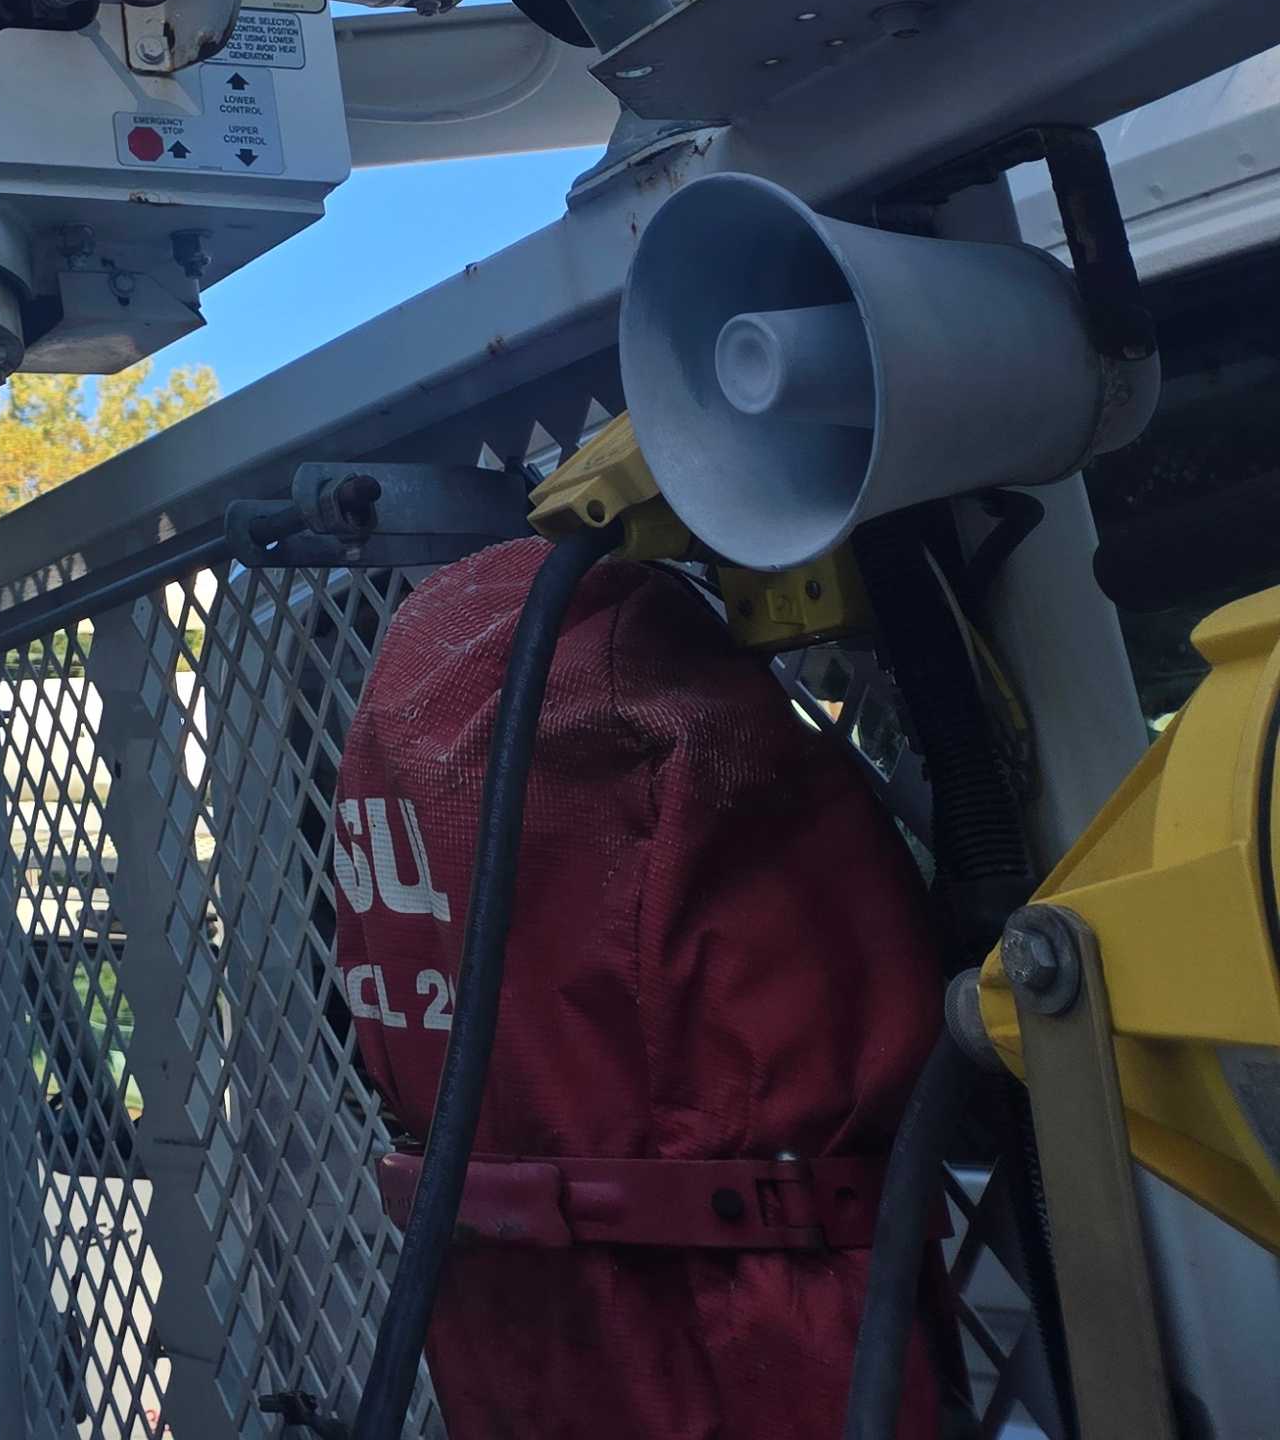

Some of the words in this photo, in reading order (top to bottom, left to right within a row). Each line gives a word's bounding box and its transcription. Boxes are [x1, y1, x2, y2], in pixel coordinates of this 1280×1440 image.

[259, 17, 296, 26] SELECTOR
[268, 27, 298, 36] POSITION
[245, 34, 266, 42] USING
[269, 36, 295, 44] LOWER
[256, 44, 277, 52] AVOID
[229, 50, 274, 60] GENERATION
[224, 95, 256, 104] LOWER
[219, 105, 263, 115] CONTROL
[133, 116, 184, 126] EMERGENCY
[228, 125, 259, 134] UPPER
[224, 135, 268, 145] CONTROL
